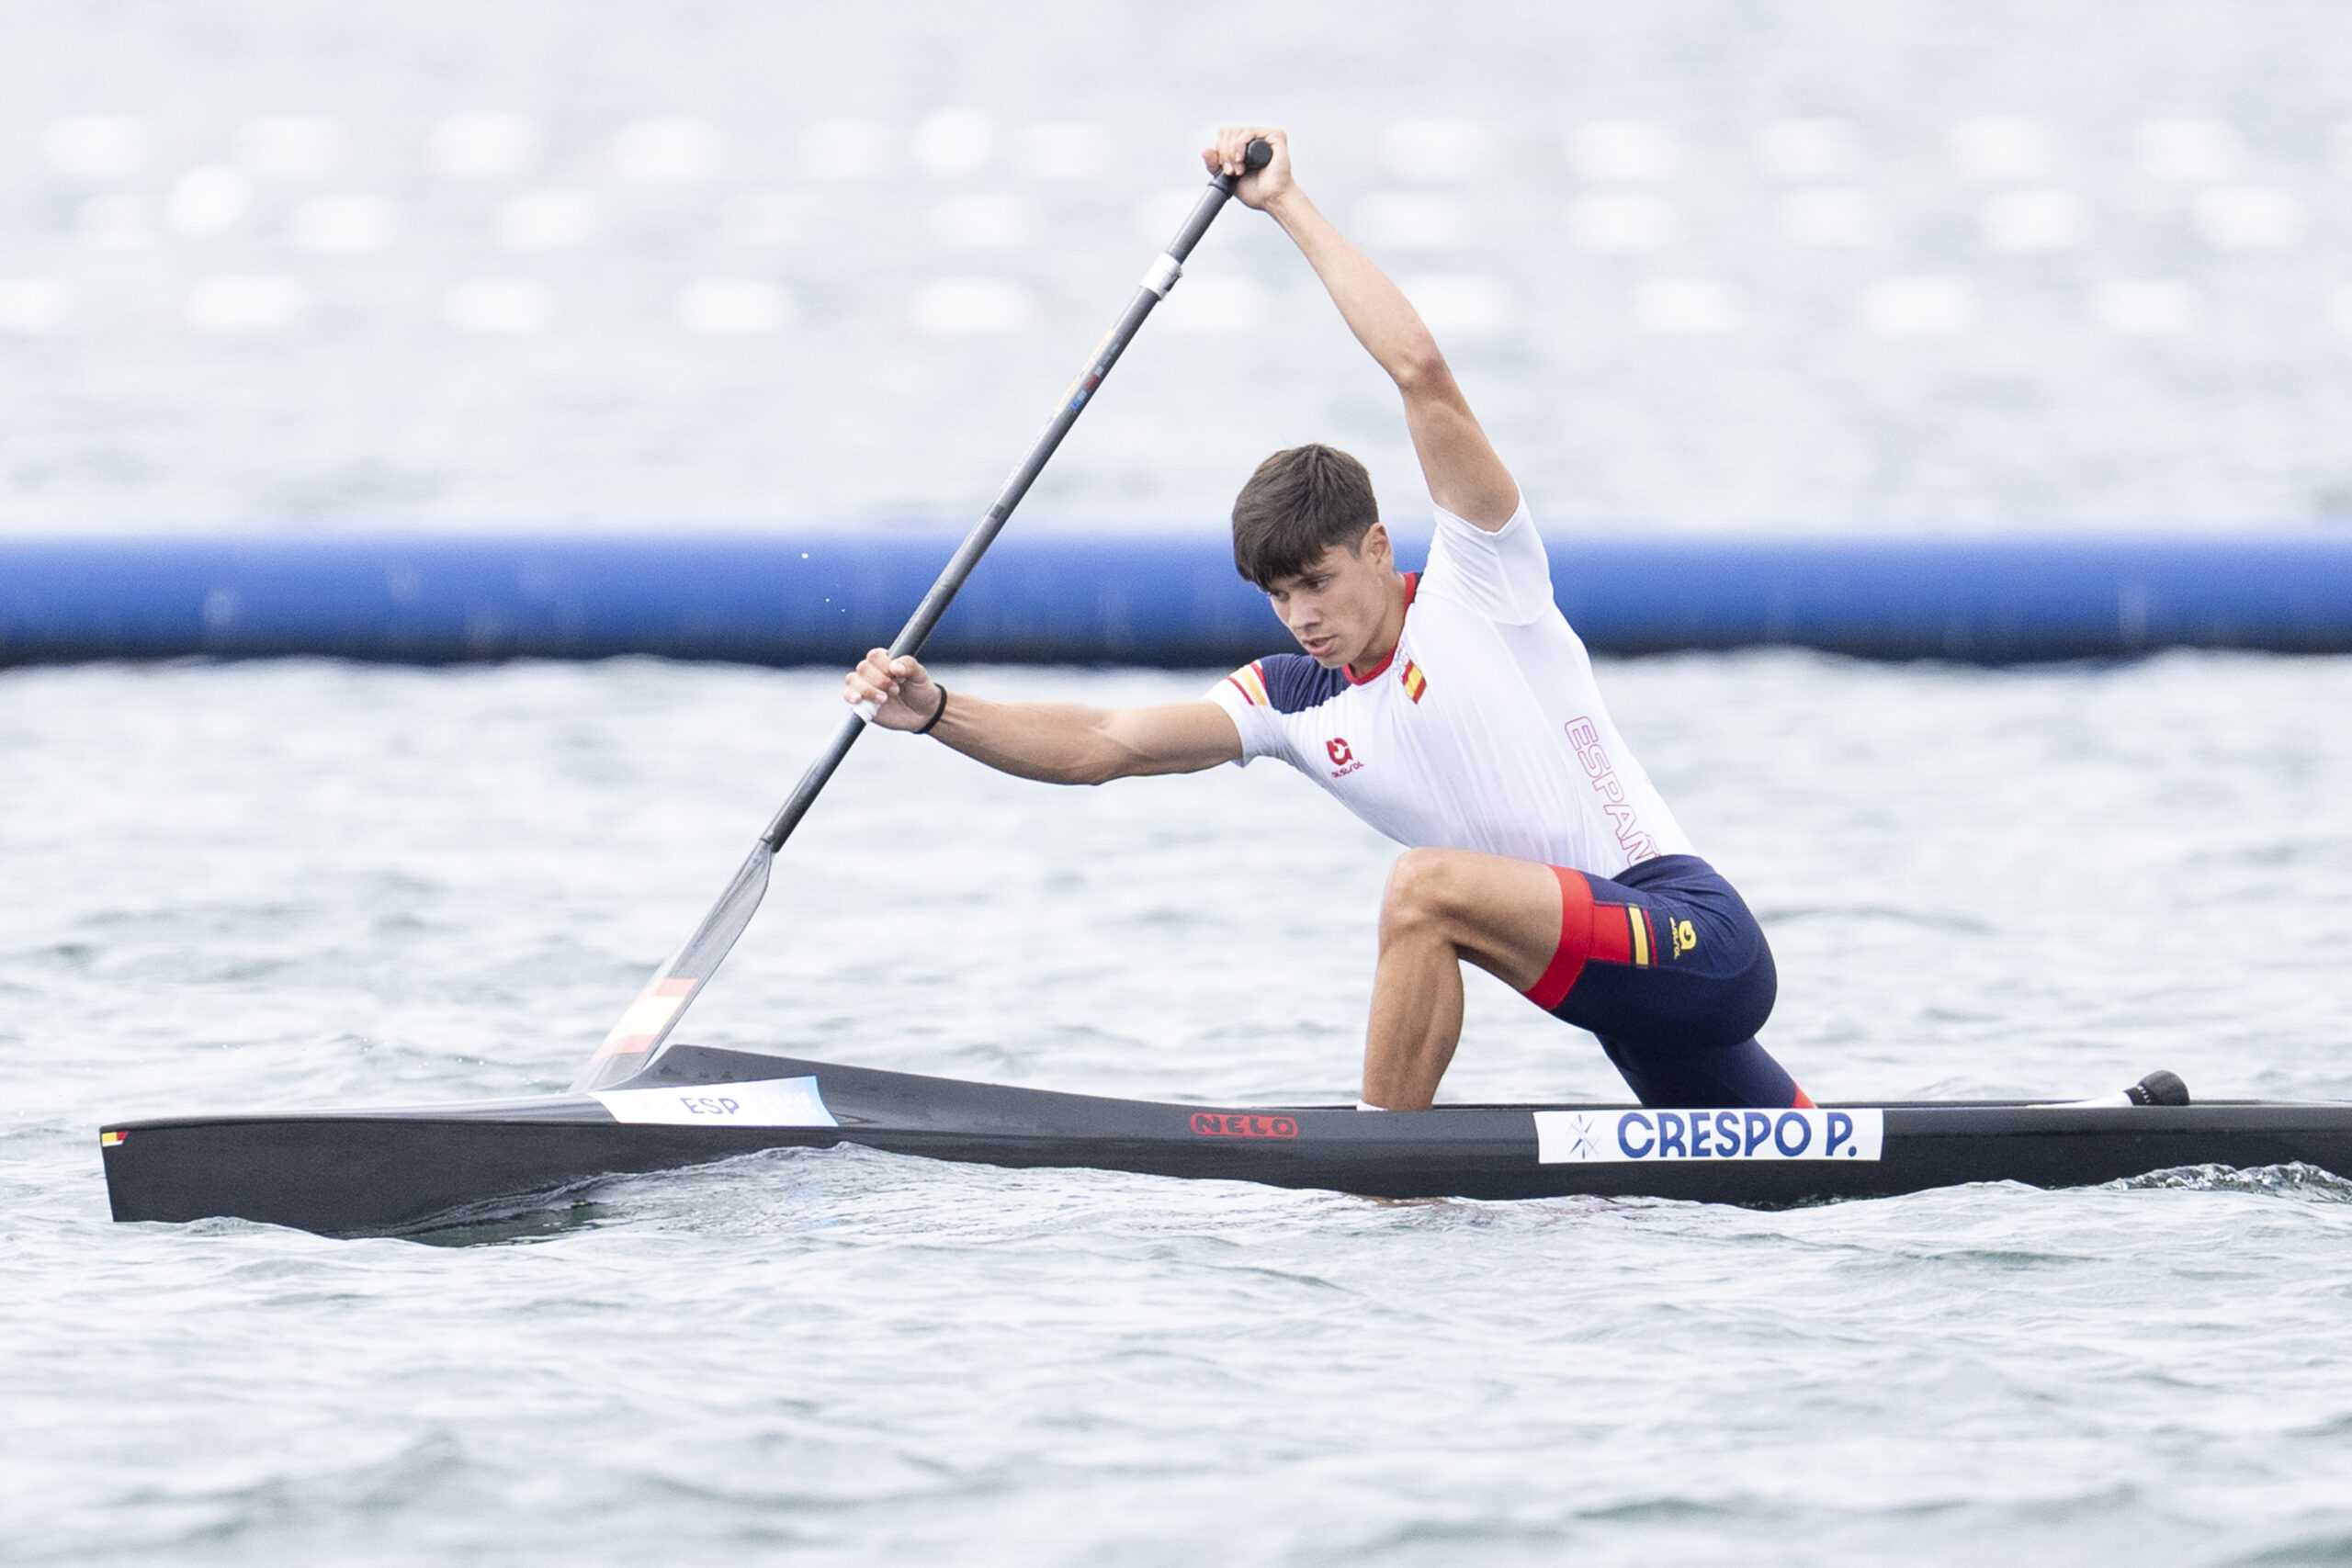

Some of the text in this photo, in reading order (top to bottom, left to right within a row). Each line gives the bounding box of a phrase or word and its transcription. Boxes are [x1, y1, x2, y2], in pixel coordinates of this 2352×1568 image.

[1565, 716, 1661, 867] ESPAÑ
[679, 1097, 741, 1116] ESP
[1193, 1115, 1295, 1135] NELO
[1617, 1111, 1858, 1159] CRESPO P.
